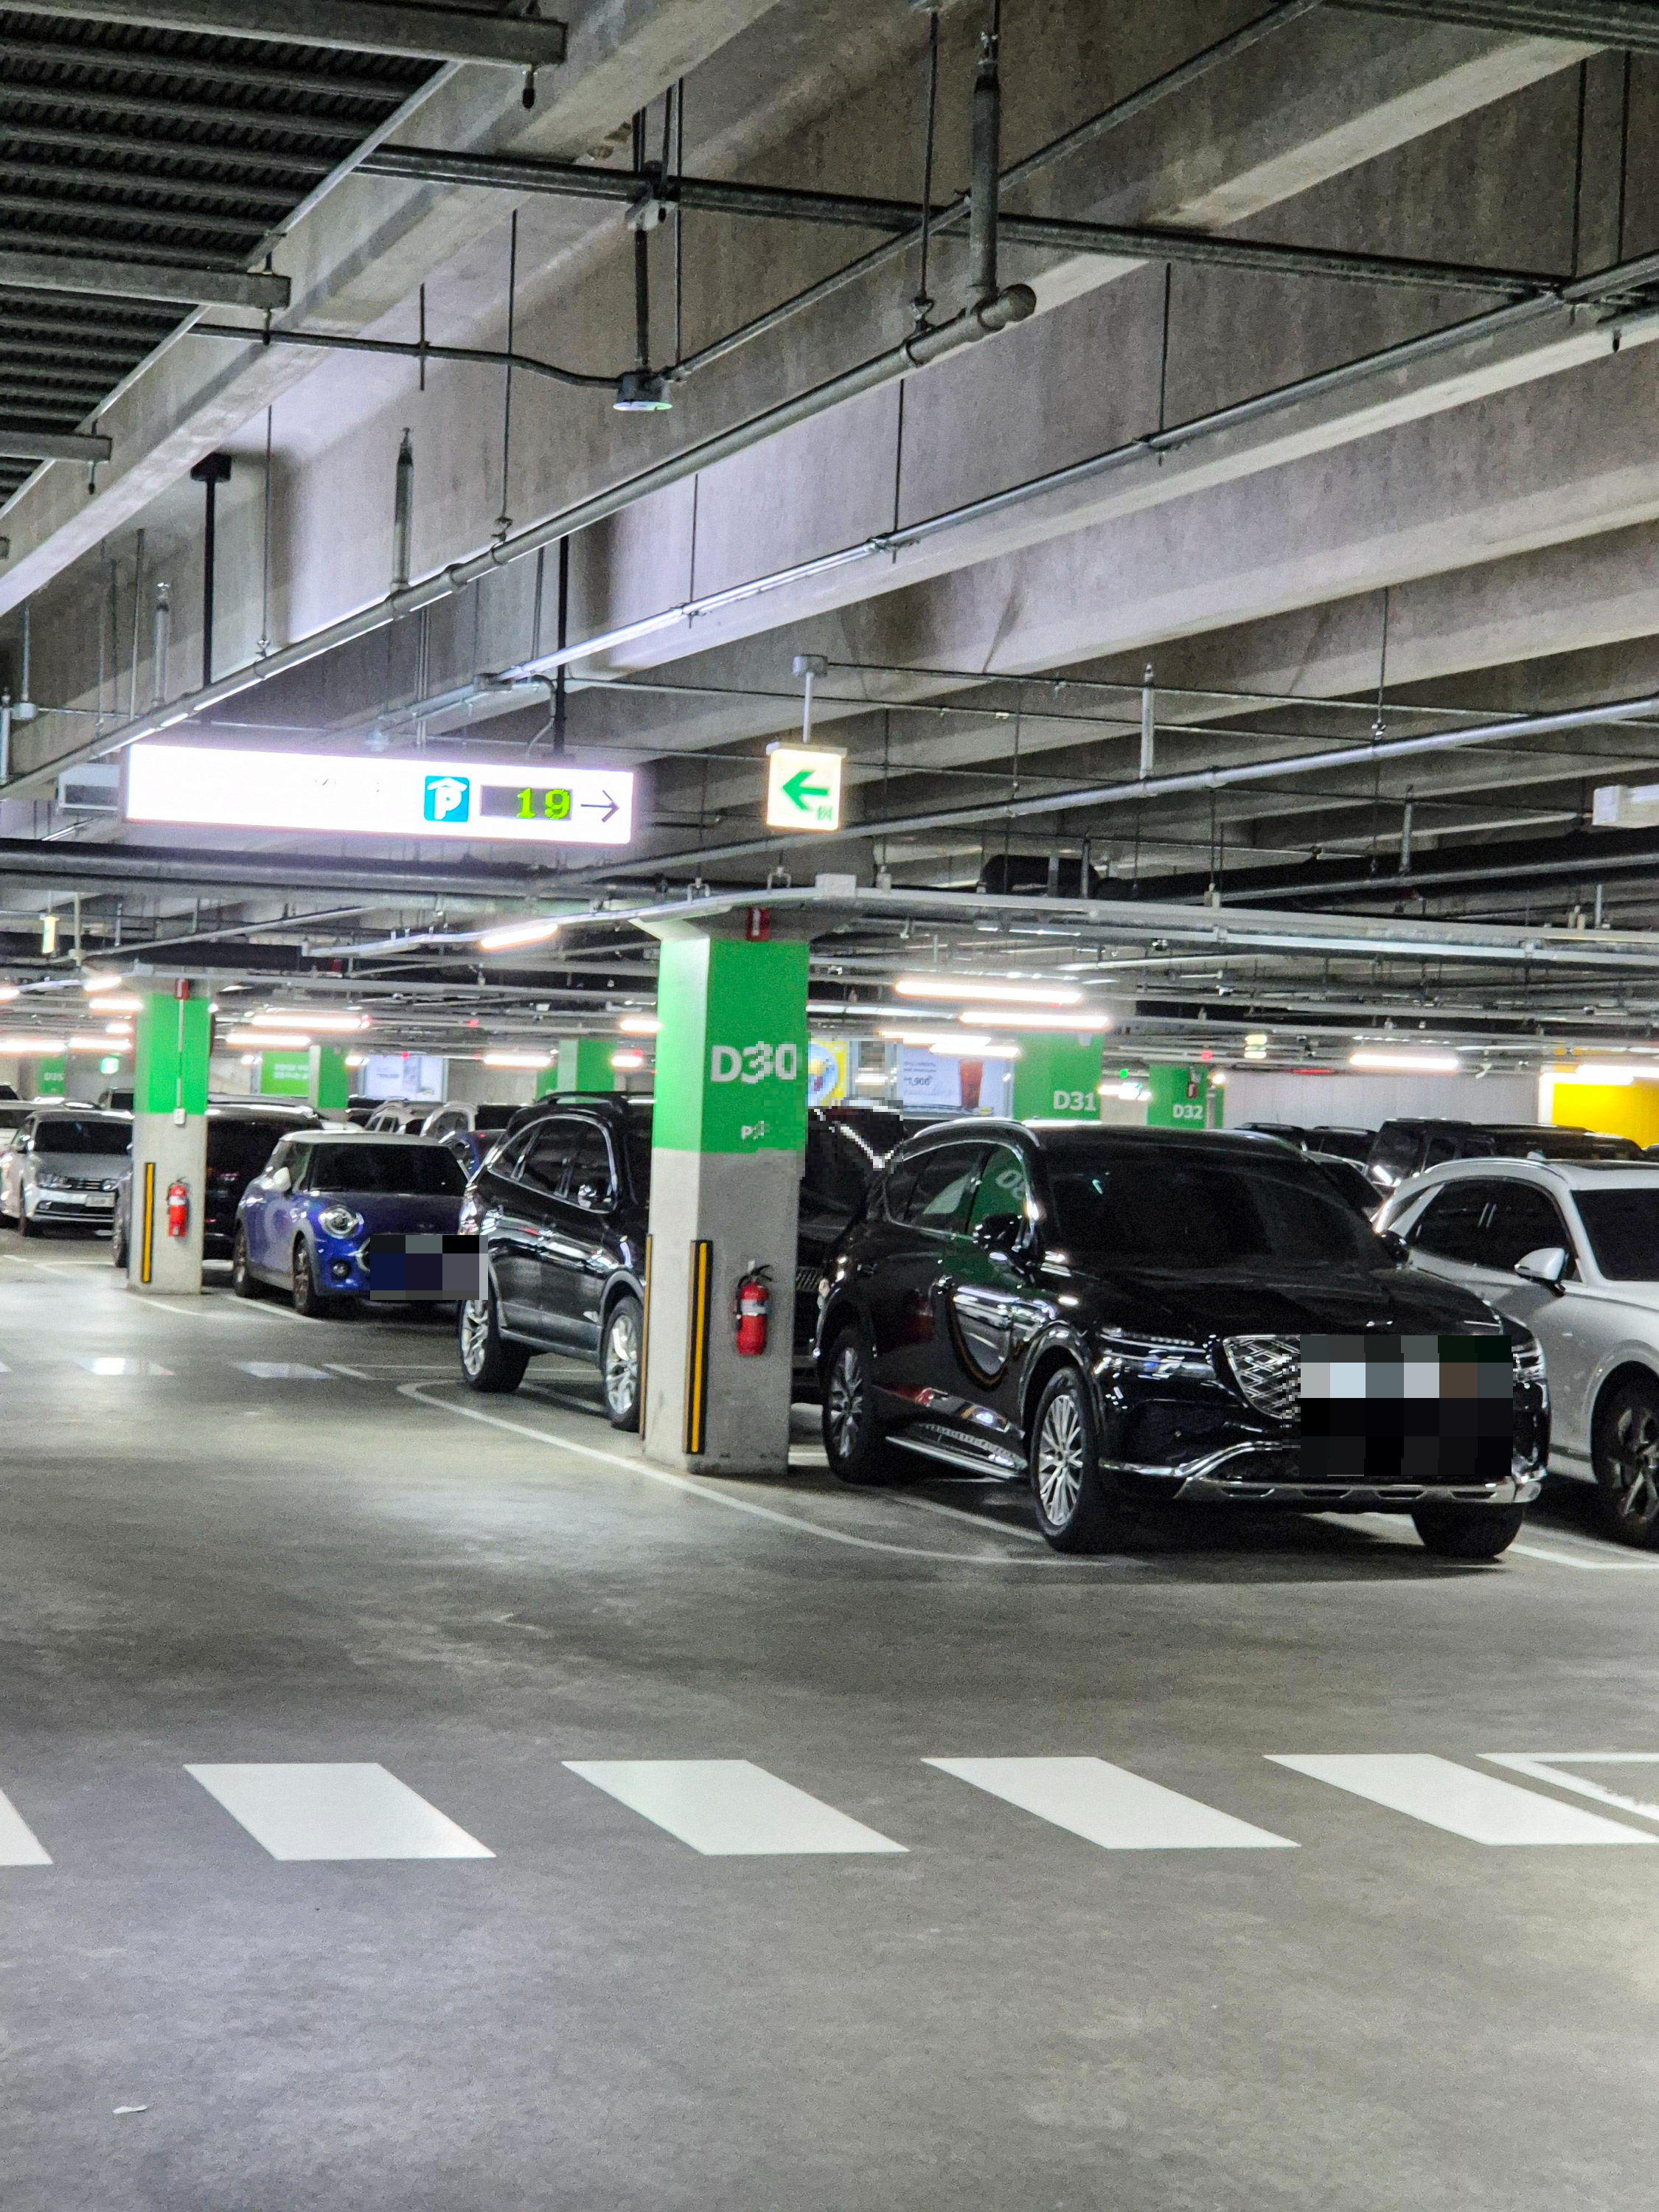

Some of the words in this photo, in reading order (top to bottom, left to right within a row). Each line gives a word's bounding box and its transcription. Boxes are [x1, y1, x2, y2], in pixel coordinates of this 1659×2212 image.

[516, 787, 570, 820] 19
[711, 1043, 796, 1084] D30
[1053, 1091, 1096, 1112] D31
[1172, 1104, 1203, 1120] D32
